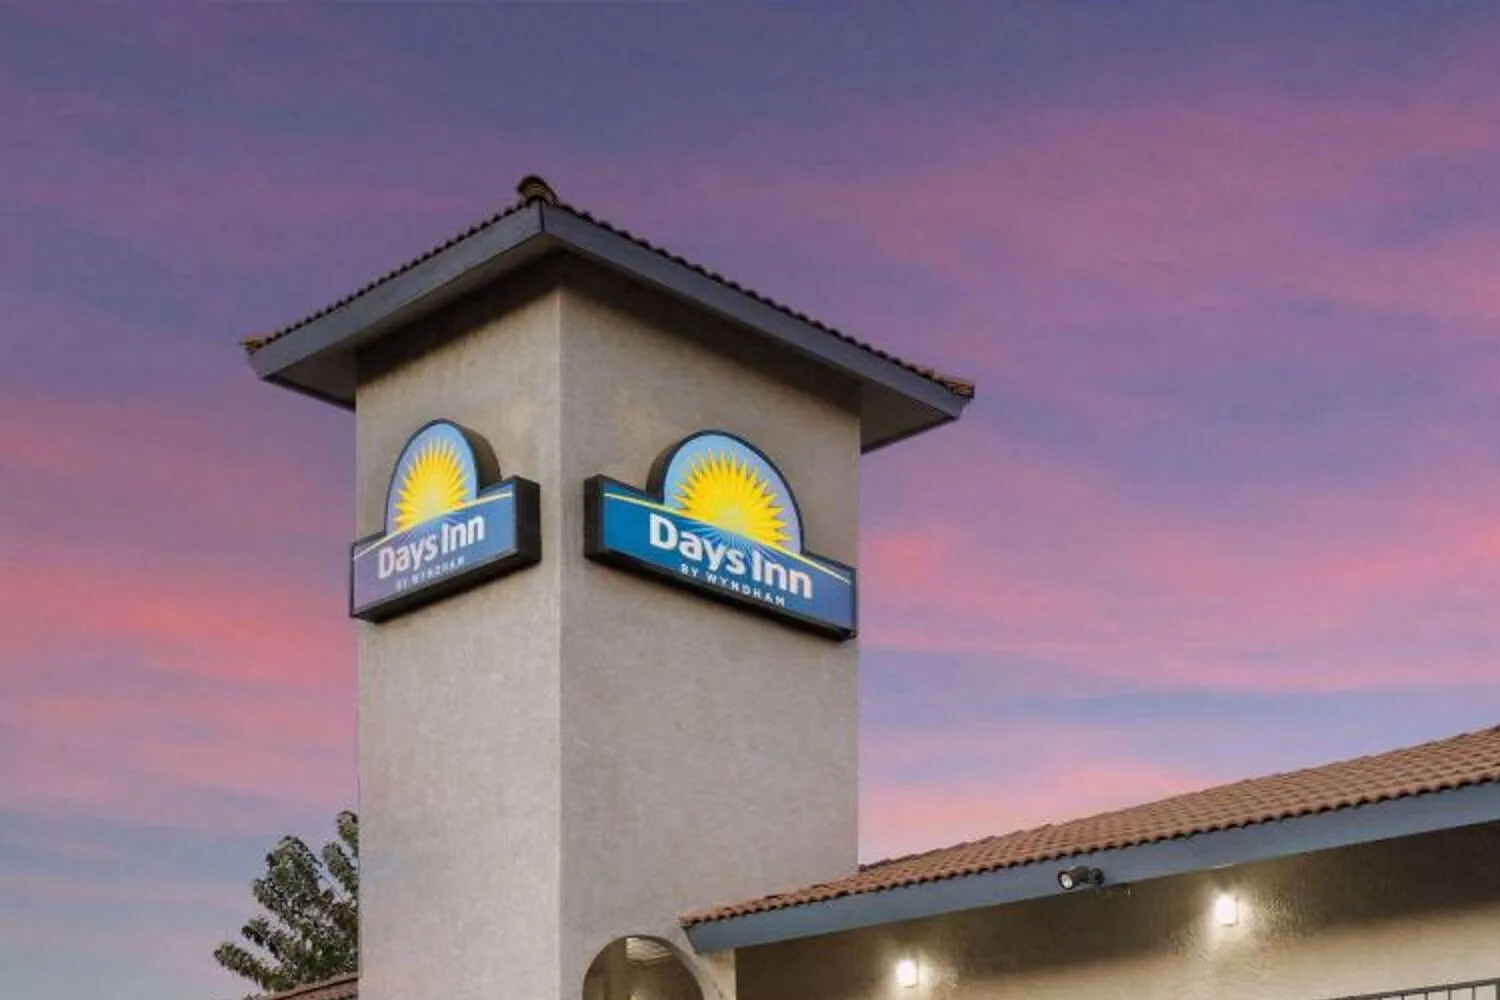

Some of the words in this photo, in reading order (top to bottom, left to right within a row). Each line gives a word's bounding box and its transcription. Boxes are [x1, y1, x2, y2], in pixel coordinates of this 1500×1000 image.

[377, 533, 438, 580] Days
[441, 515, 485, 555] Inn
[649, 512, 747, 575] Days
[751, 550, 814, 599] Inn
[680, 563, 699, 576] BY
[705, 571, 786, 607] WYNDHAM
